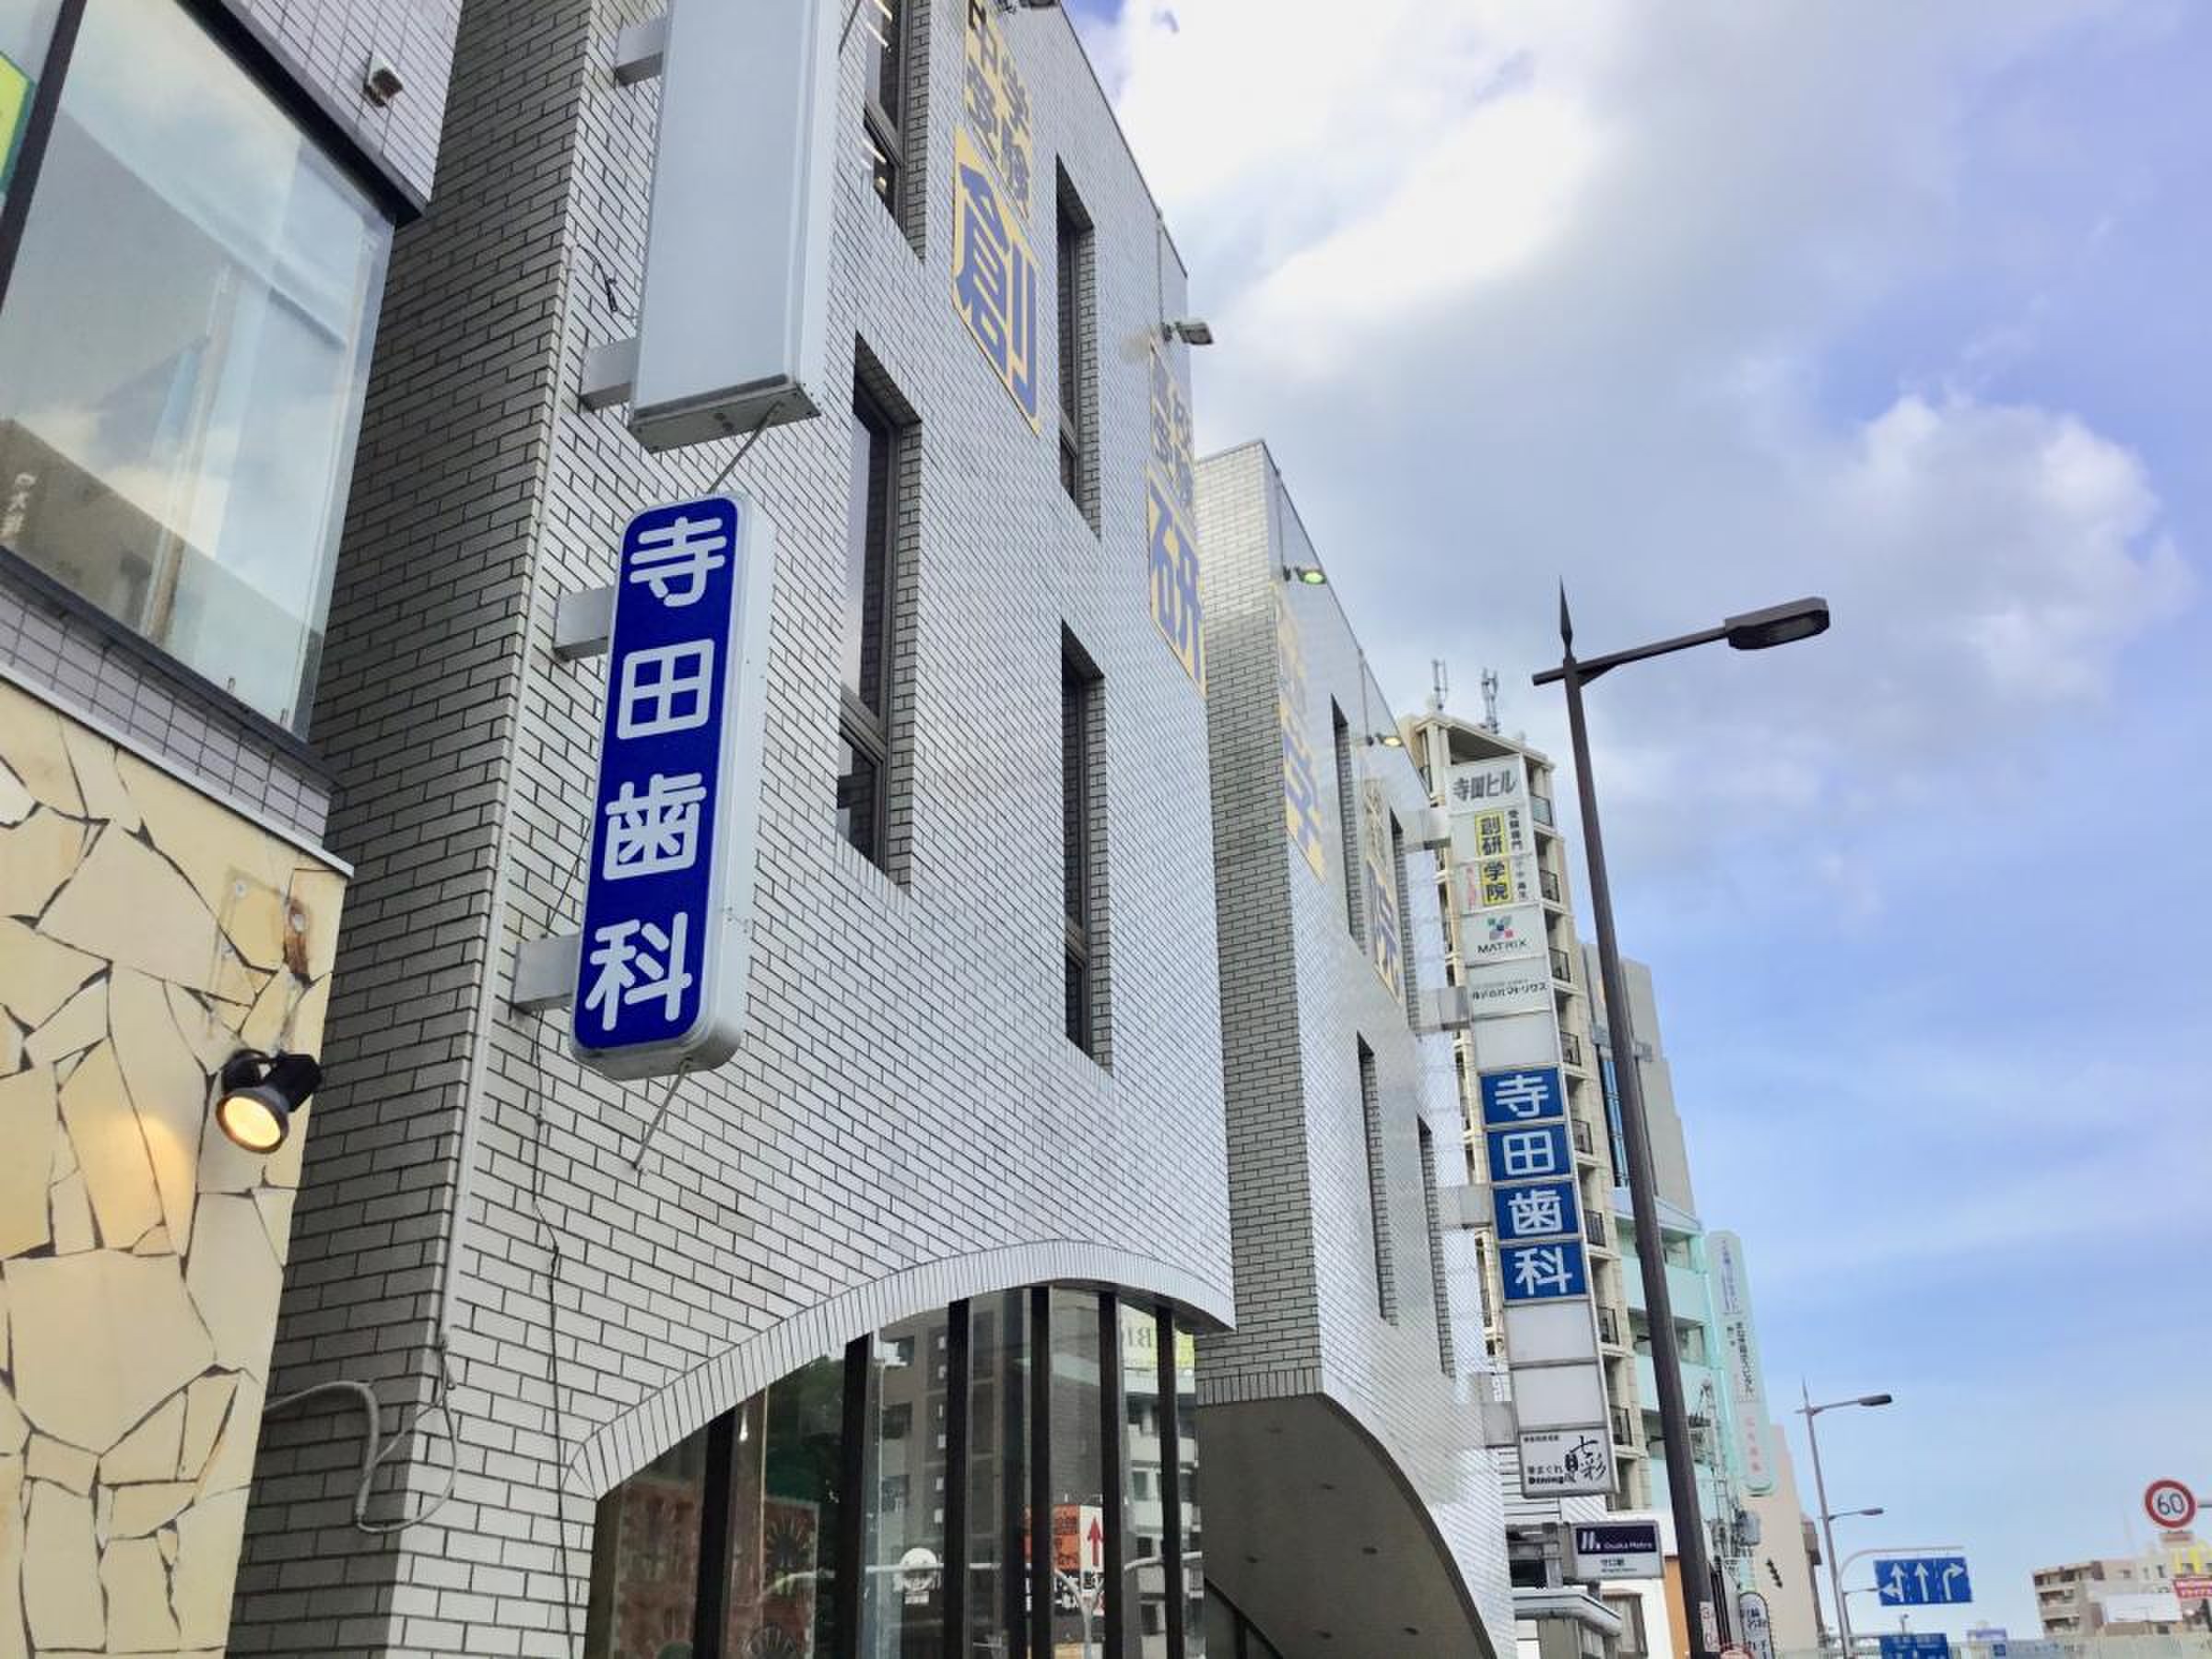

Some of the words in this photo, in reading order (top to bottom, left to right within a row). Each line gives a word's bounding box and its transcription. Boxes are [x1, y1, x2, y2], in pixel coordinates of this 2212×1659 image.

[956, 162, 1037, 418] 創
[584, 516, 727, 1031] 寺田歯科
[1477, 938, 1527, 954] MATRIX
[1494, 1074, 1573, 1296] 寺田歯科
[2158, 1493, 2185, 1516] 60
